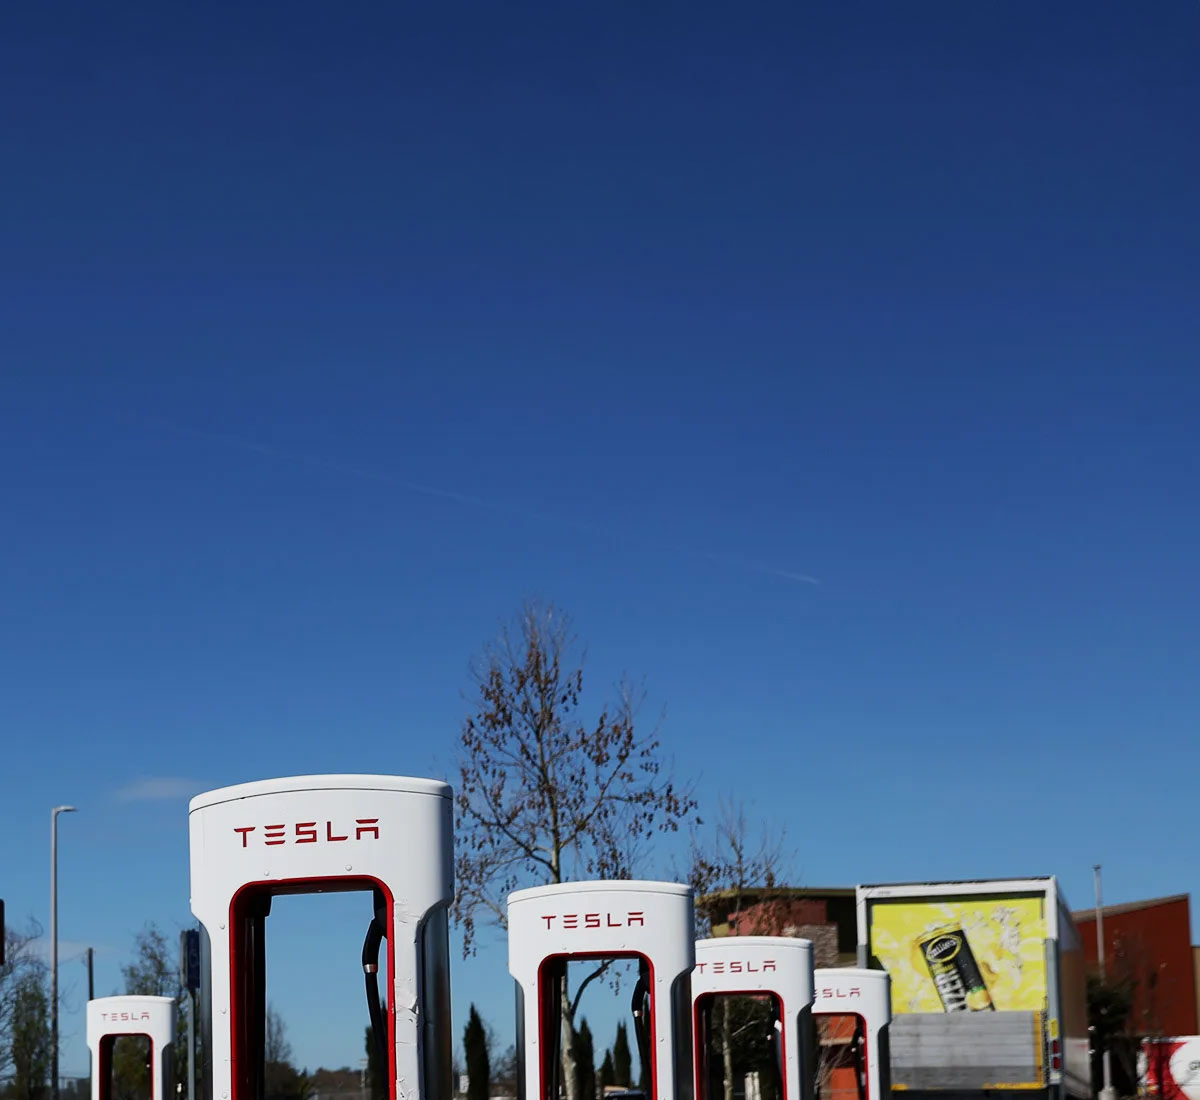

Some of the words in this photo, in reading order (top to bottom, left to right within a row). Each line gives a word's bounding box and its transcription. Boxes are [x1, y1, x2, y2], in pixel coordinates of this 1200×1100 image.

[235, 819, 379, 848] TESLA
[542, 912, 644, 930] TESLA
[695, 960, 777, 974] TESLA
[814, 988, 861, 999] SLA
[101, 1011, 151, 1022] TESLA
